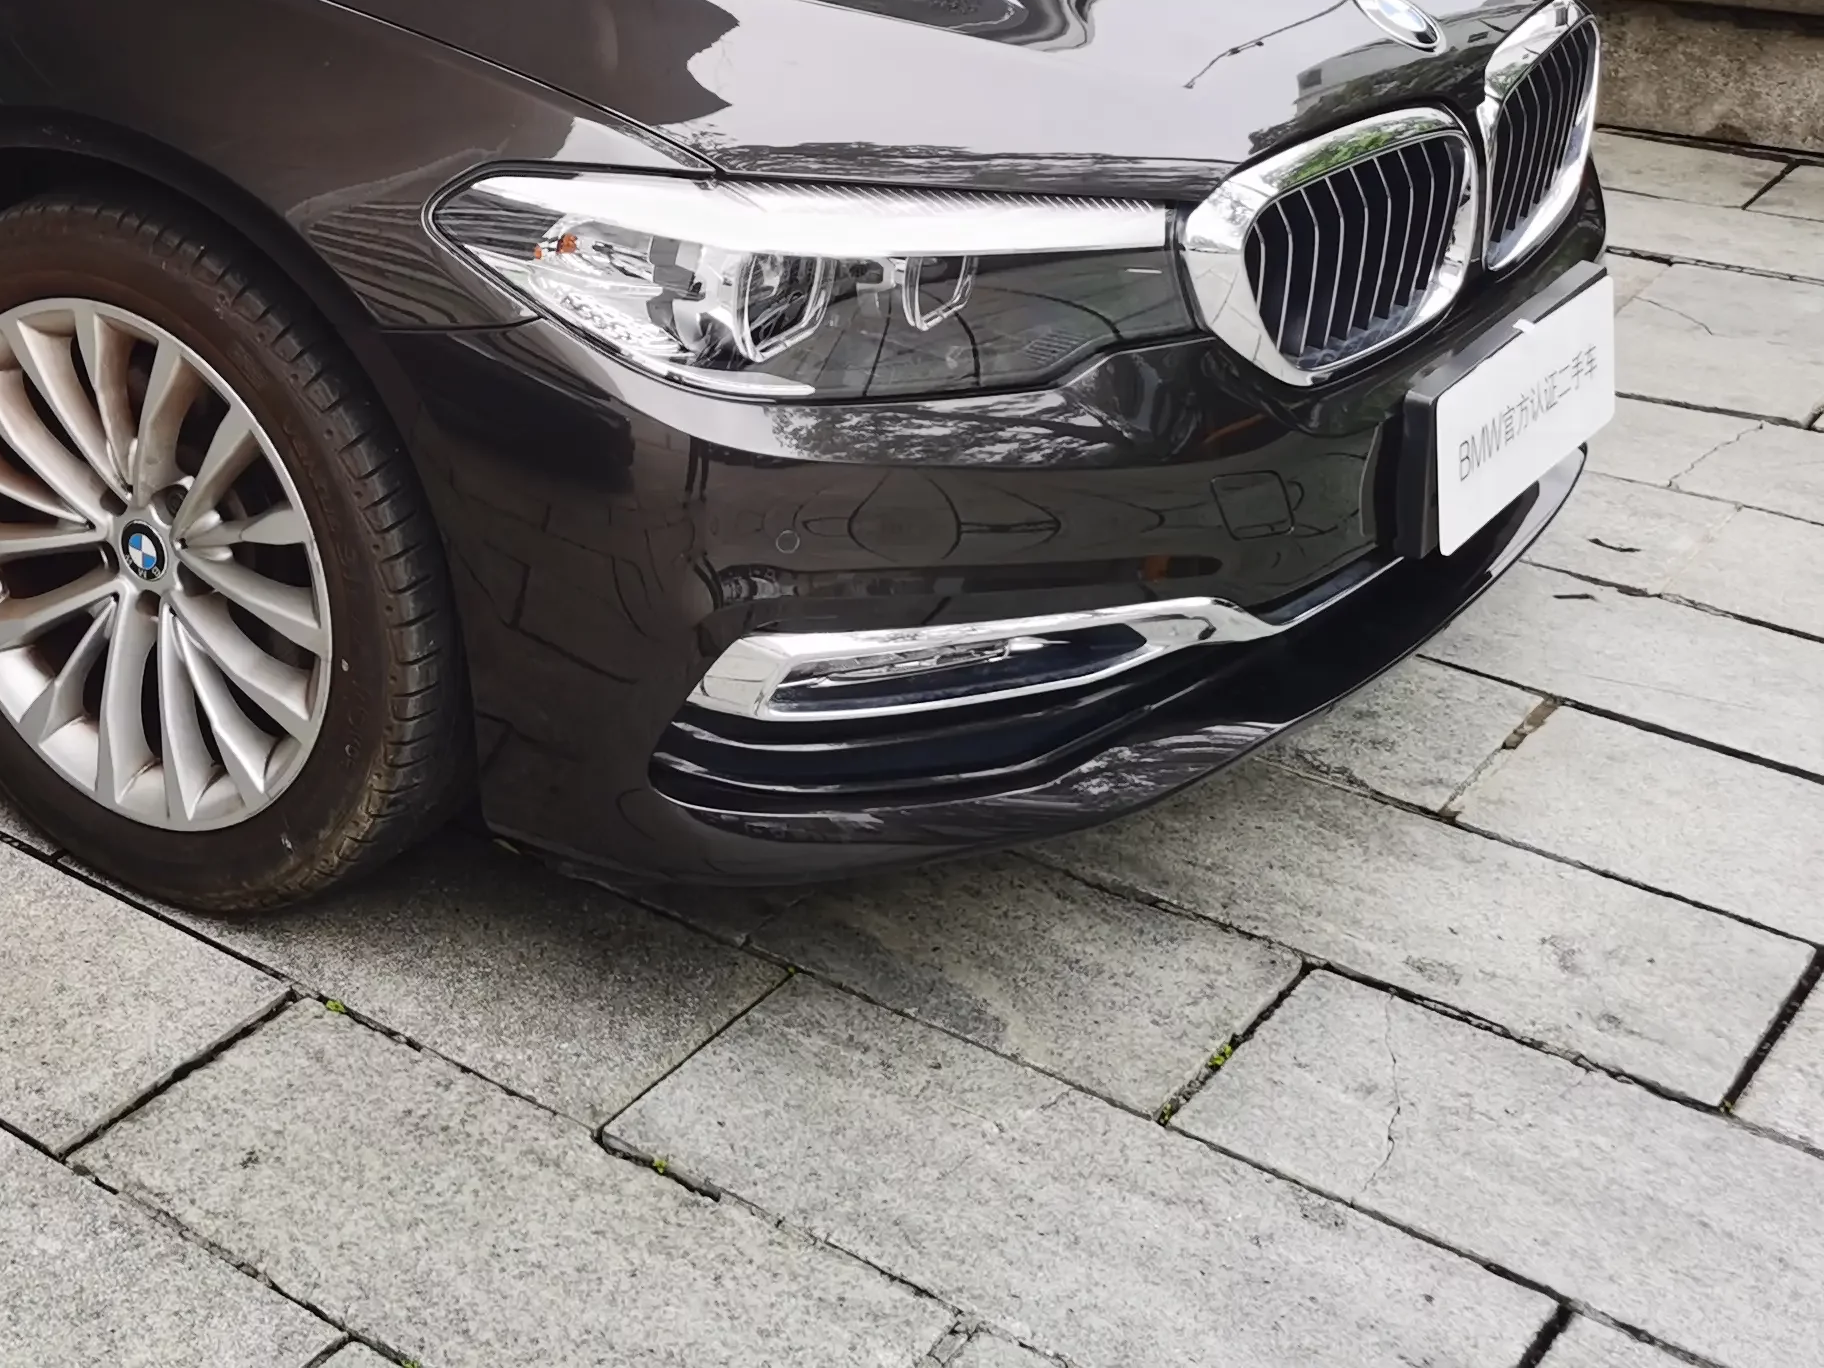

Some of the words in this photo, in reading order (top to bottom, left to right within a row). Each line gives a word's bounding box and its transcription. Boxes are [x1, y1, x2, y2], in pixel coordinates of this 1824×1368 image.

[1458, 344, 1598, 482] BMW官方认证二手车
